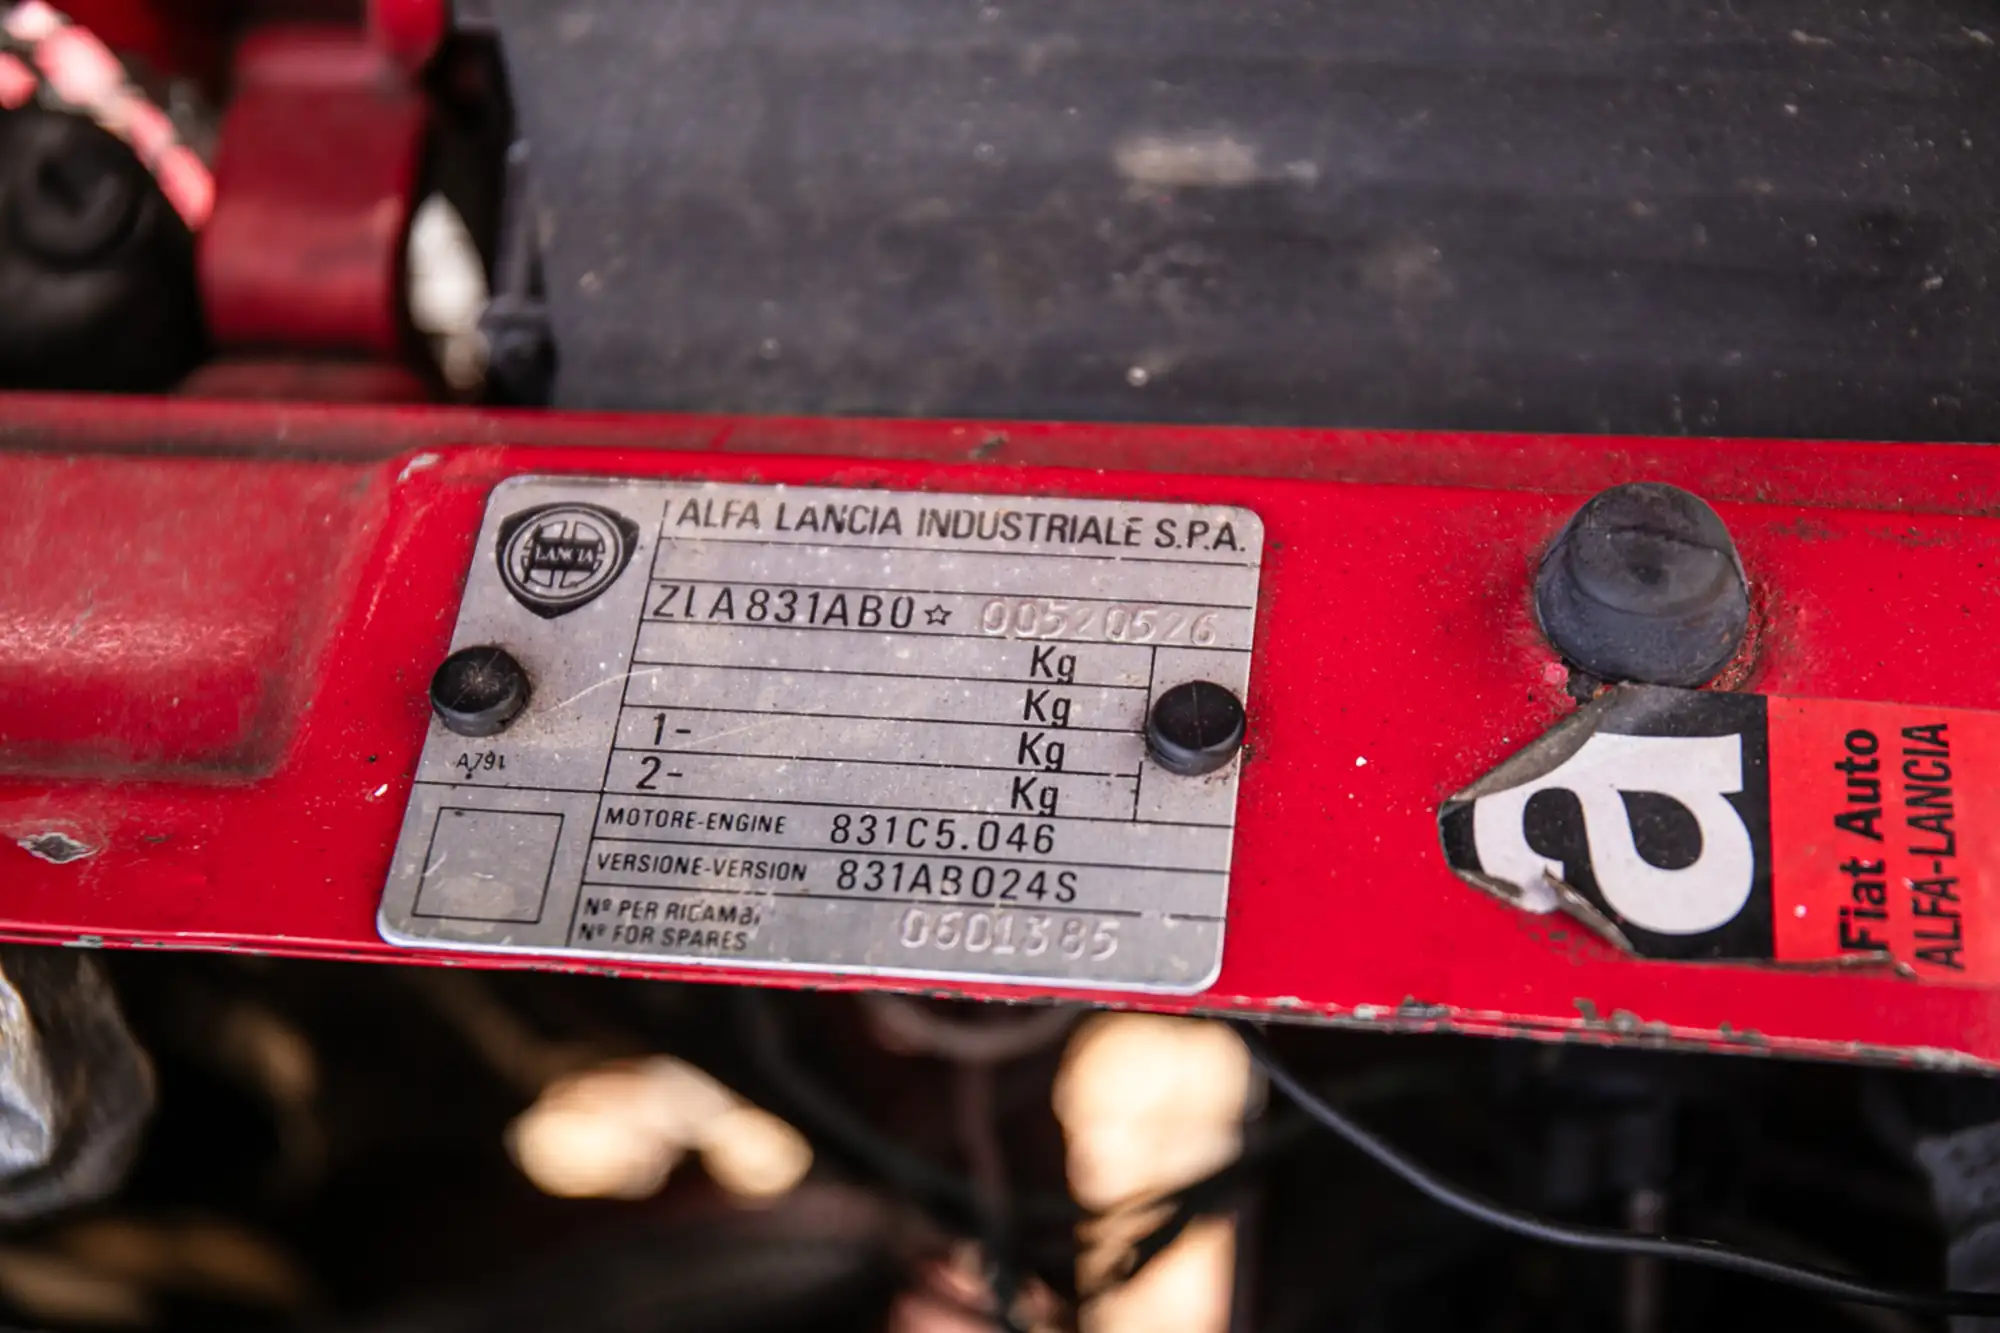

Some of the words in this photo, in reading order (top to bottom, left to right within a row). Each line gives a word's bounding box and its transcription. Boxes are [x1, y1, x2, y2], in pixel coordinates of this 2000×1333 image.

[676, 498, 760, 529] ALFA
[775, 502, 902, 537] LANCIA
[916, 507, 1144, 546] INDUSTRIALE
[1154, 517, 1246, 552] S.P.A.
[535, 545, 594, 563] LANCIA
[1029, 645, 1076, 685] Kg
[1023, 689, 1071, 728] Kg
[1017, 731, 1065, 772] Kg
[1010, 775, 1058, 817] Kg
[1833, 728, 1884, 842] Auto
[604, 806, 787, 835] MOTORE-ENGINE
[830, 813, 1056, 854] 831C5.046
[1901, 722, 1965, 973] ALFA-LANCIA
[597, 854, 806, 882] VERSIONE-VERSION
[836, 858, 1077, 902] 831AB024S
[617, 899, 659, 919] PER
[1838, 858, 1888, 953] Fiat
[611, 924, 656, 945] FOR
[660, 927, 748, 951] SPARES
